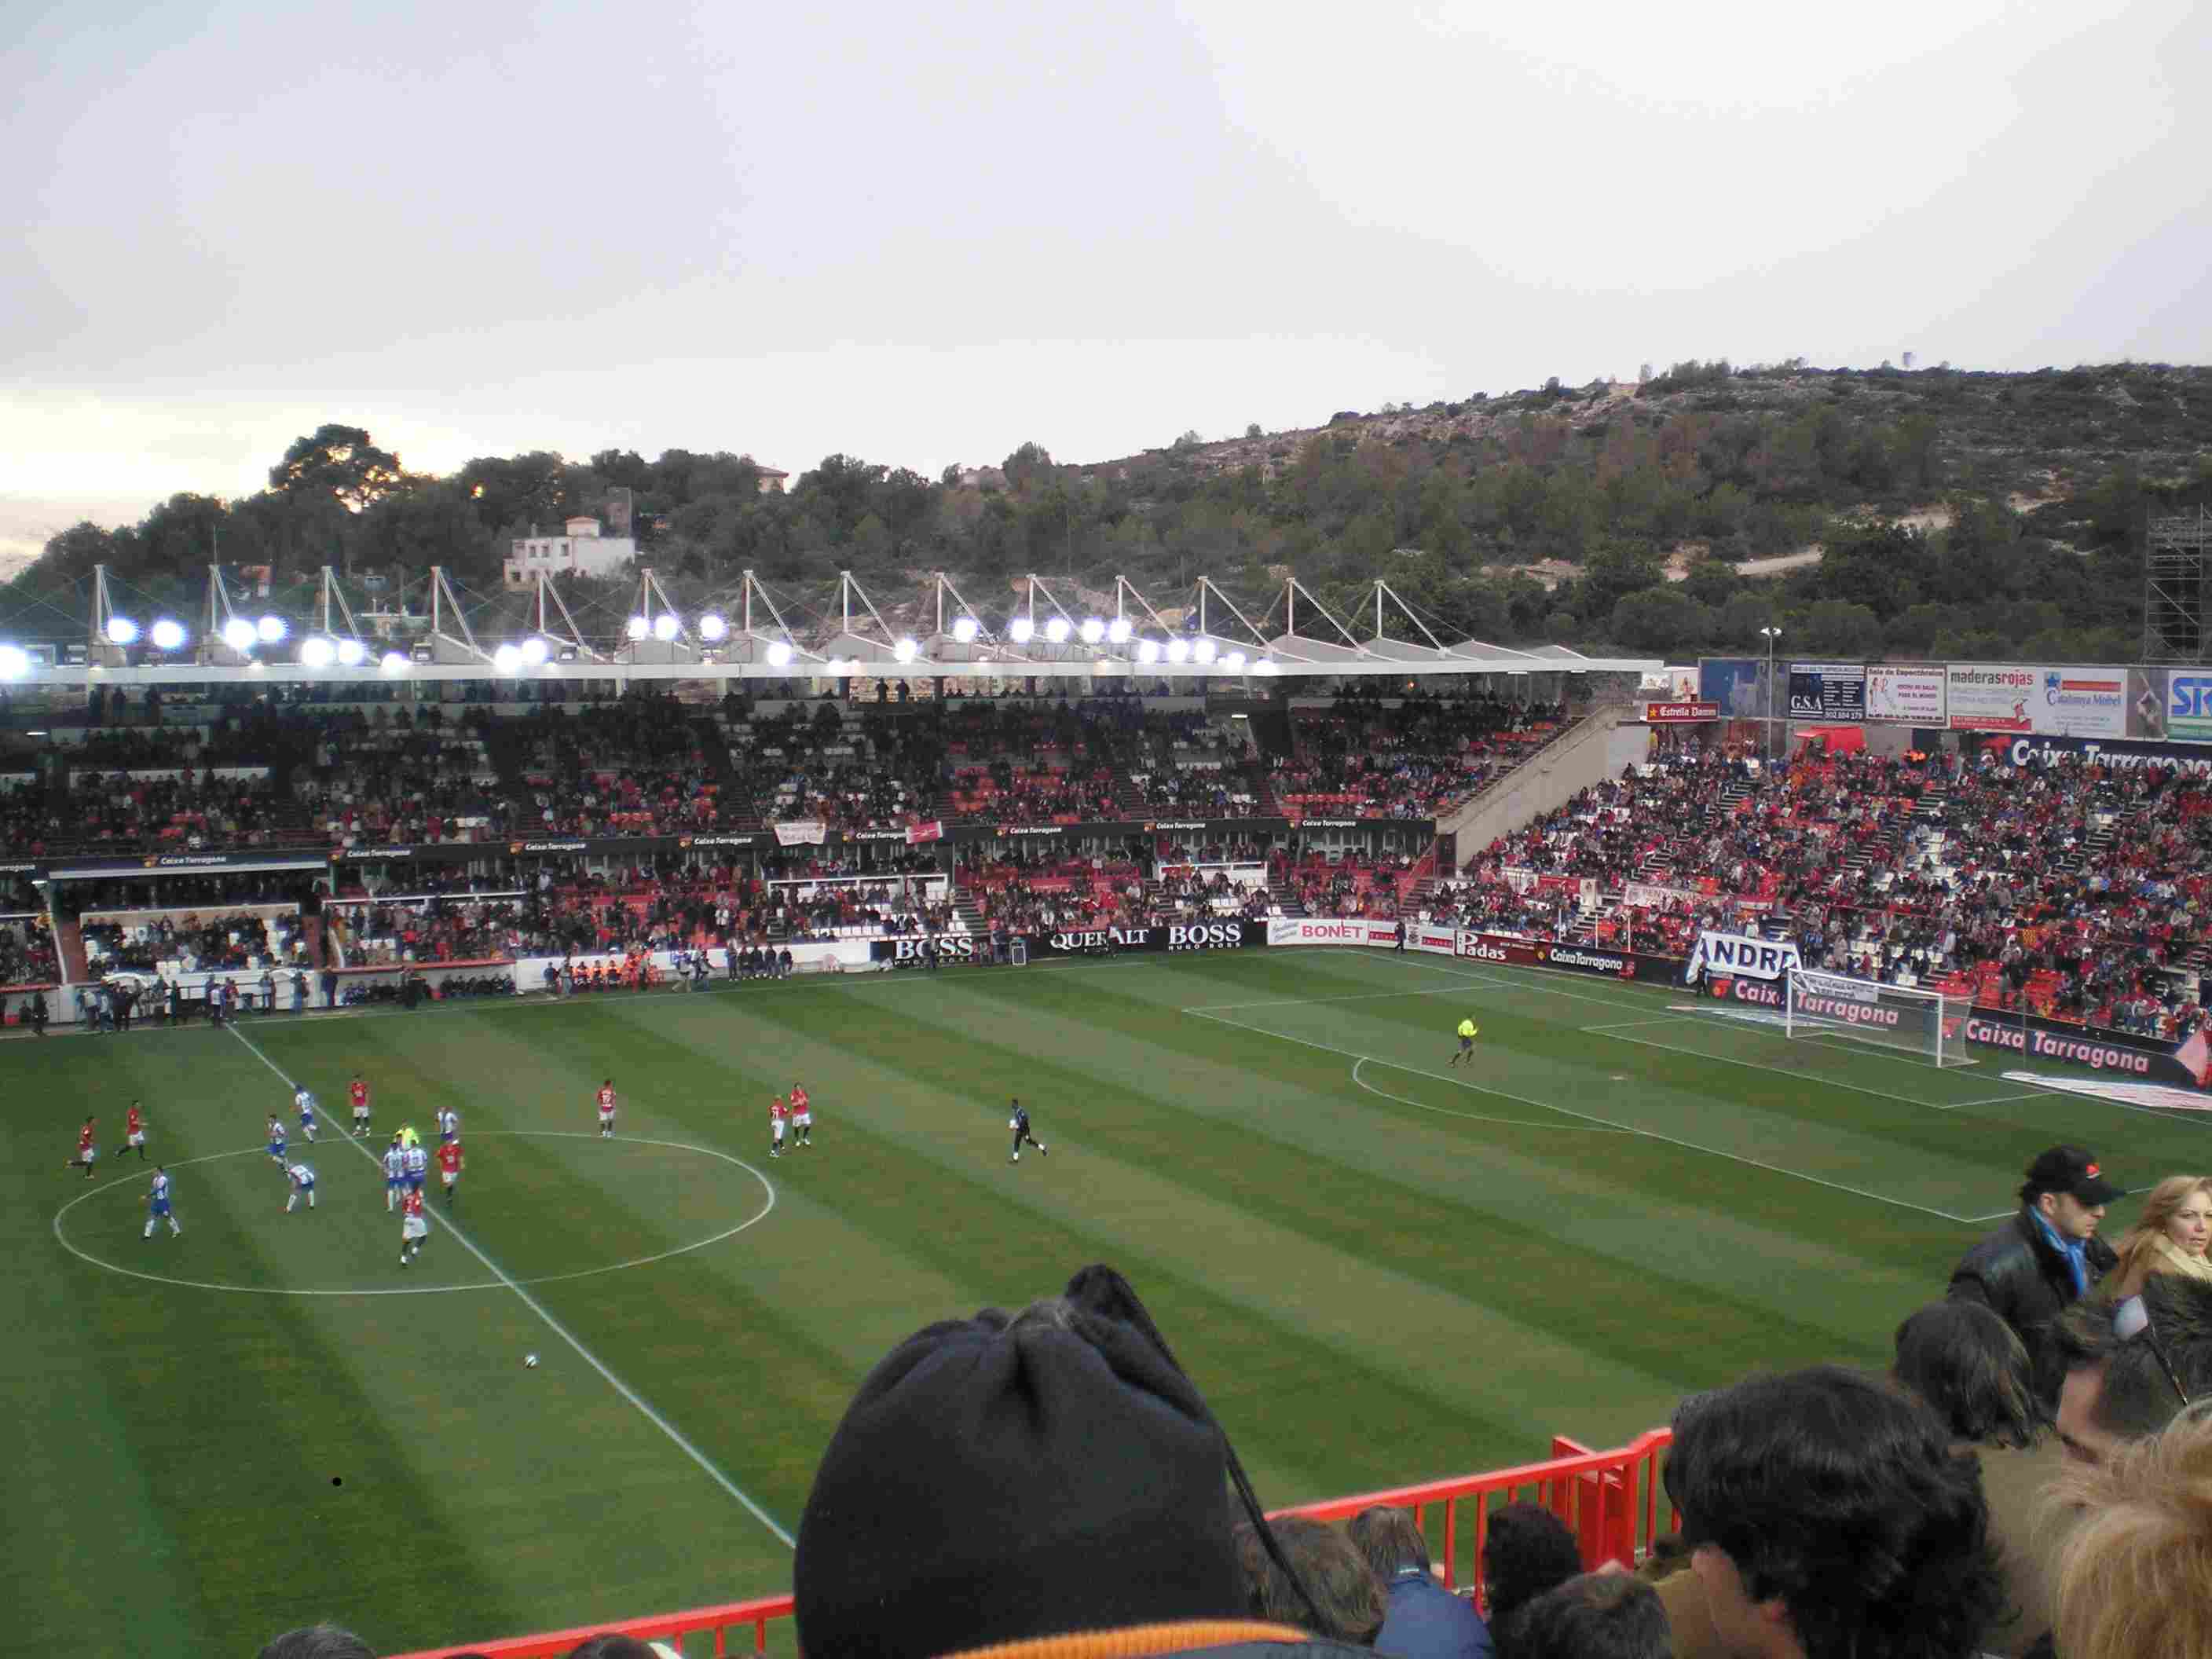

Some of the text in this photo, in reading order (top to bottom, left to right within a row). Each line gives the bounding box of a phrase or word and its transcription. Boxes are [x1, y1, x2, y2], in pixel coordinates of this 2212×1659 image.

[1950, 668, 2034, 689] maderasrojas
[1659, 706, 1689, 717] Estrella
[1791, 695, 1822, 710] G.S.A
[1168, 923, 1241, 944] BOSS
[1302, 925, 1363, 938] BONET
[1550, 948, 1622, 971] Caixa Tarragona
[1735, 980, 1784, 1005] Caix
[1797, 992, 1899, 1024] Tarragona
[1966, 1020, 2149, 1072] Caixa Tarragona
